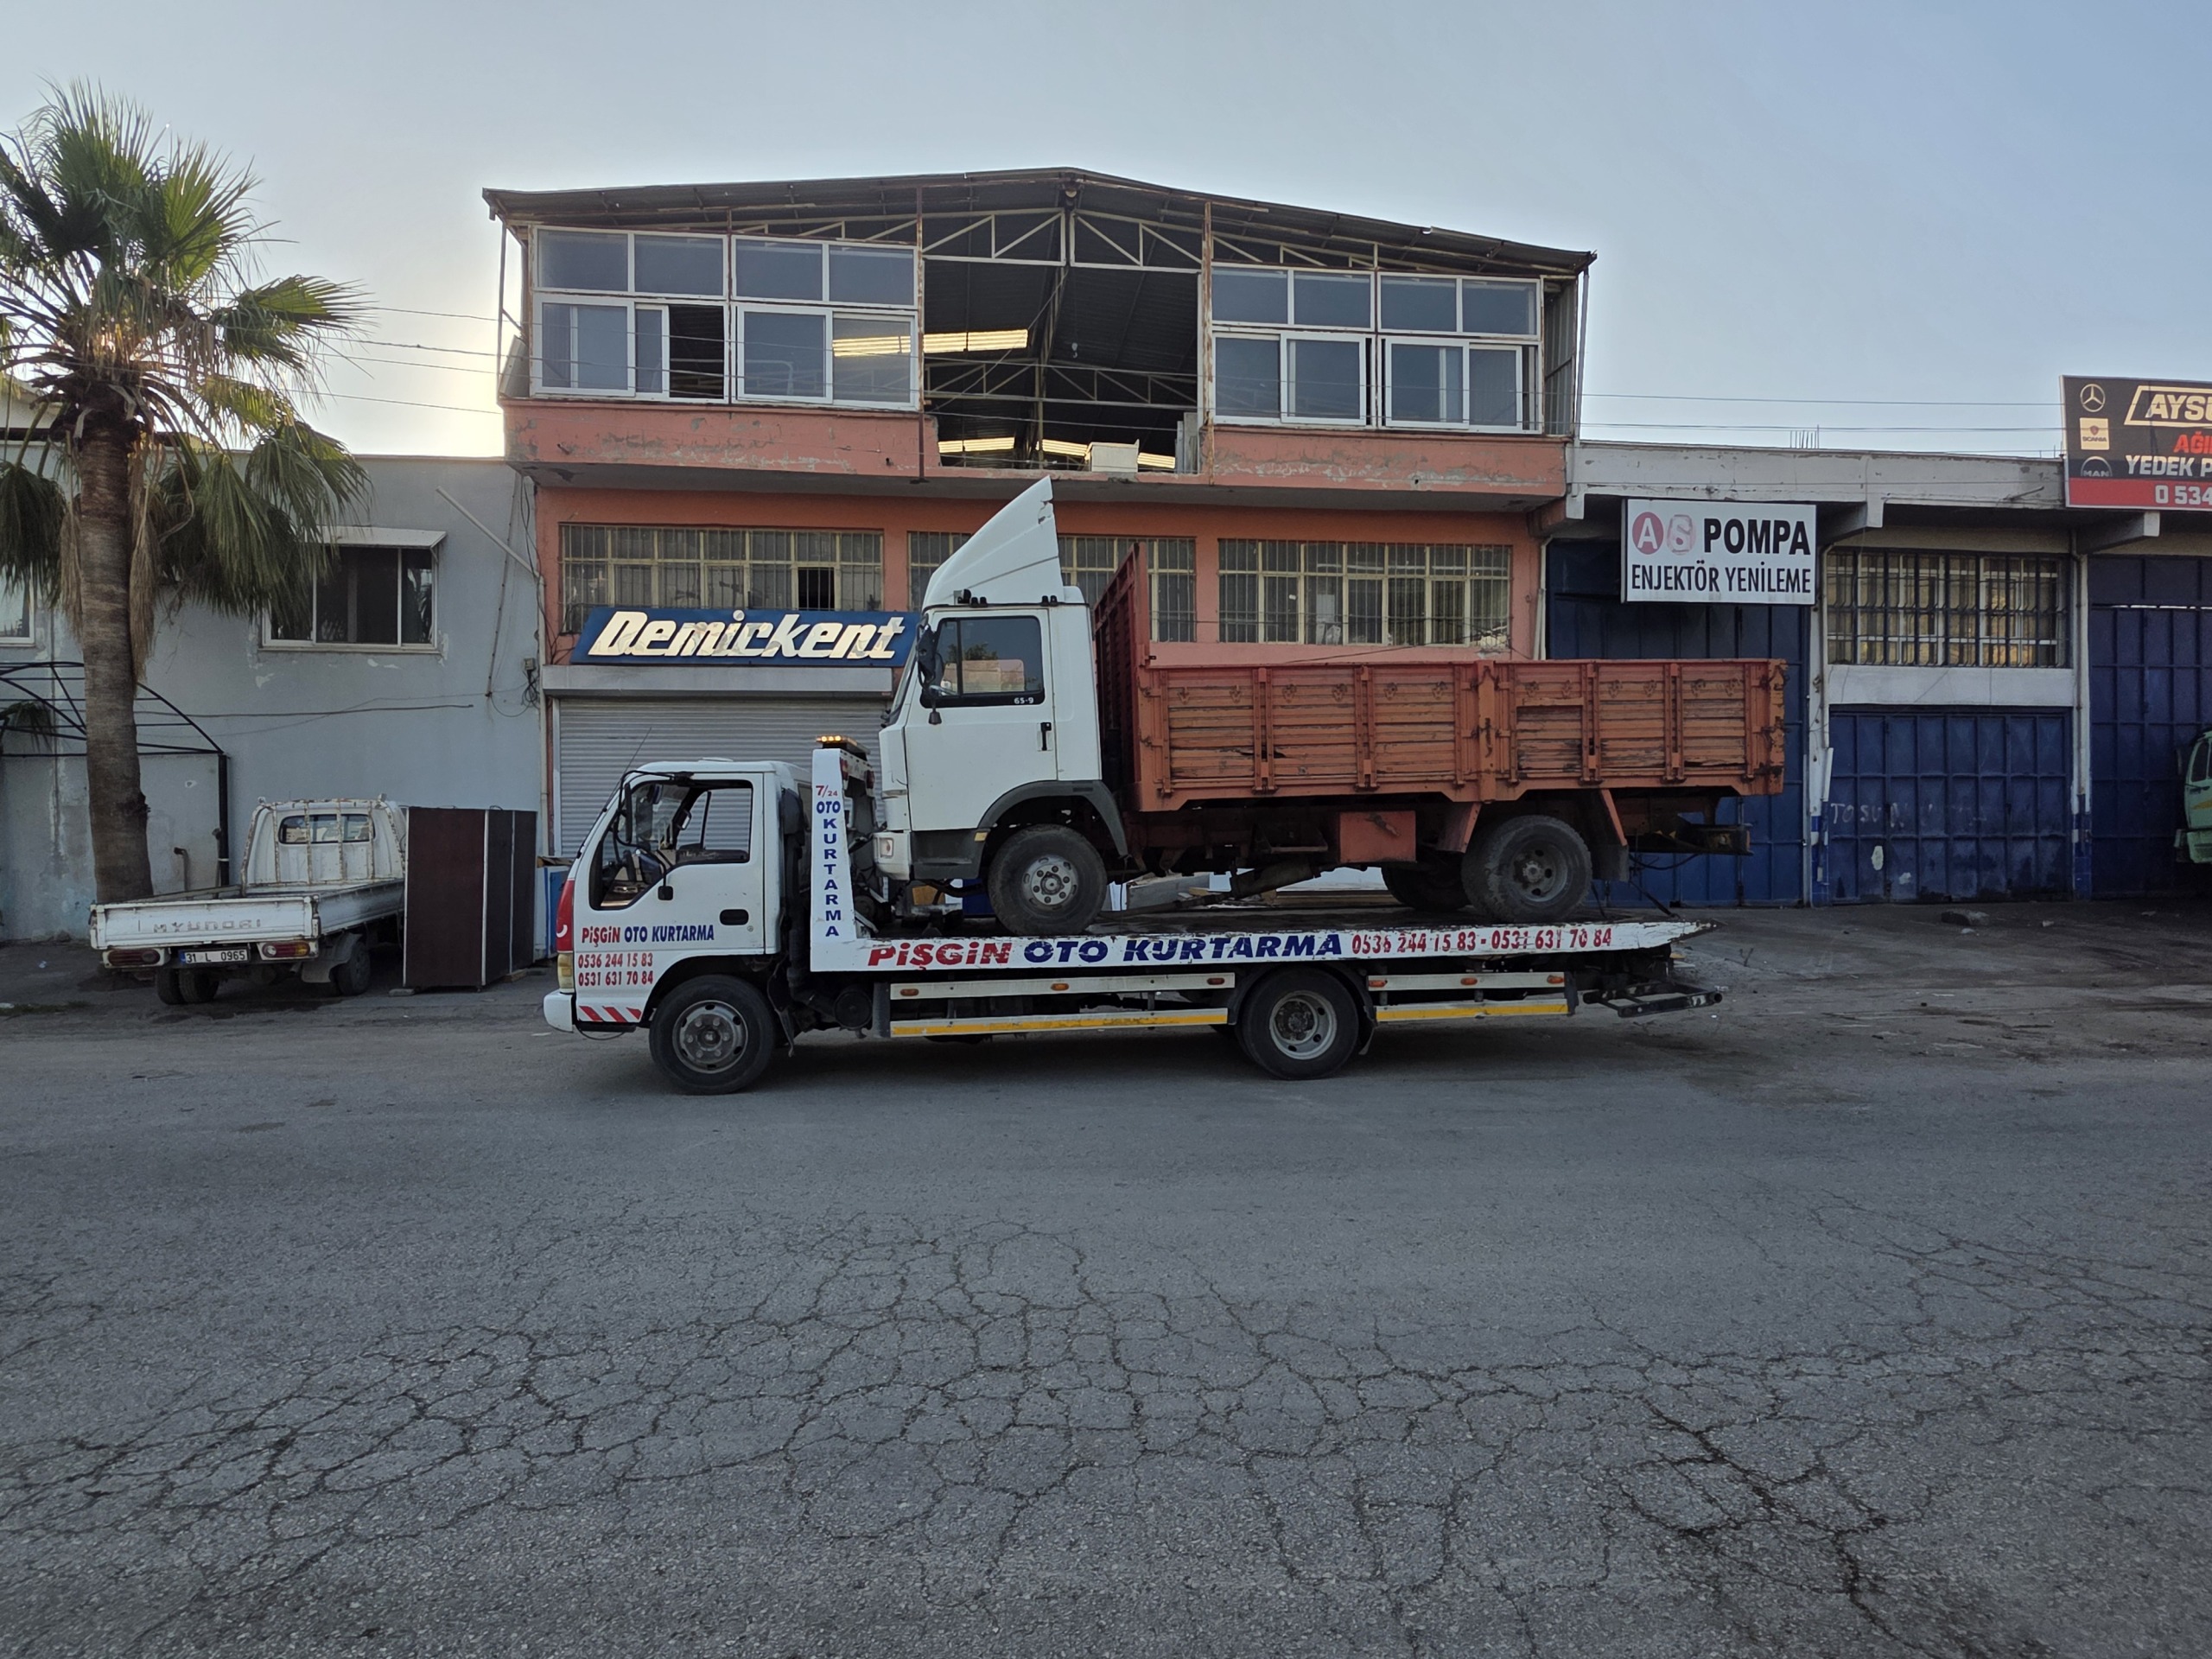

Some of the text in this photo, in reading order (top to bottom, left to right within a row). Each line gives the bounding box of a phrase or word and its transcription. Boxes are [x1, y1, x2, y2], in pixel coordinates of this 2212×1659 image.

[2173, 431, 2212, 454] AĞI
[2126, 454, 2195, 476] YEDEK
[2155, 485, 2169, 504] 0
[1704, 518, 1811, 555] POMPA
[1631, 560, 1811, 593] ENJEKTÖR YENİLEME
[816, 785, 838, 798] 7/24
[817, 800, 841, 814] OTO
[823, 818, 842, 937] KURTARMA
[624, 925, 647, 943] OTO
[652, 925, 715, 942] KURTARMA
[1024, 940, 1108, 963] OTO
[1123, 934, 1342, 962] KURTARMA
[1351, 934, 1392, 954] 0536
[1396, 933, 1427, 953] 244
[1433, 933, 1451, 952] 15
[1457, 931, 1477, 950] 83
[1491, 930, 1529, 950] 0531
[1535, 929, 1561, 949] 631
[1569, 928, 1588, 948] 70
[1593, 927, 1612, 947] 84
[186, 950, 246, 963] 31 L 0965
[578, 952, 653, 969] 0536 244 15 83
[578, 970, 653, 987] 0531 631 70 84
